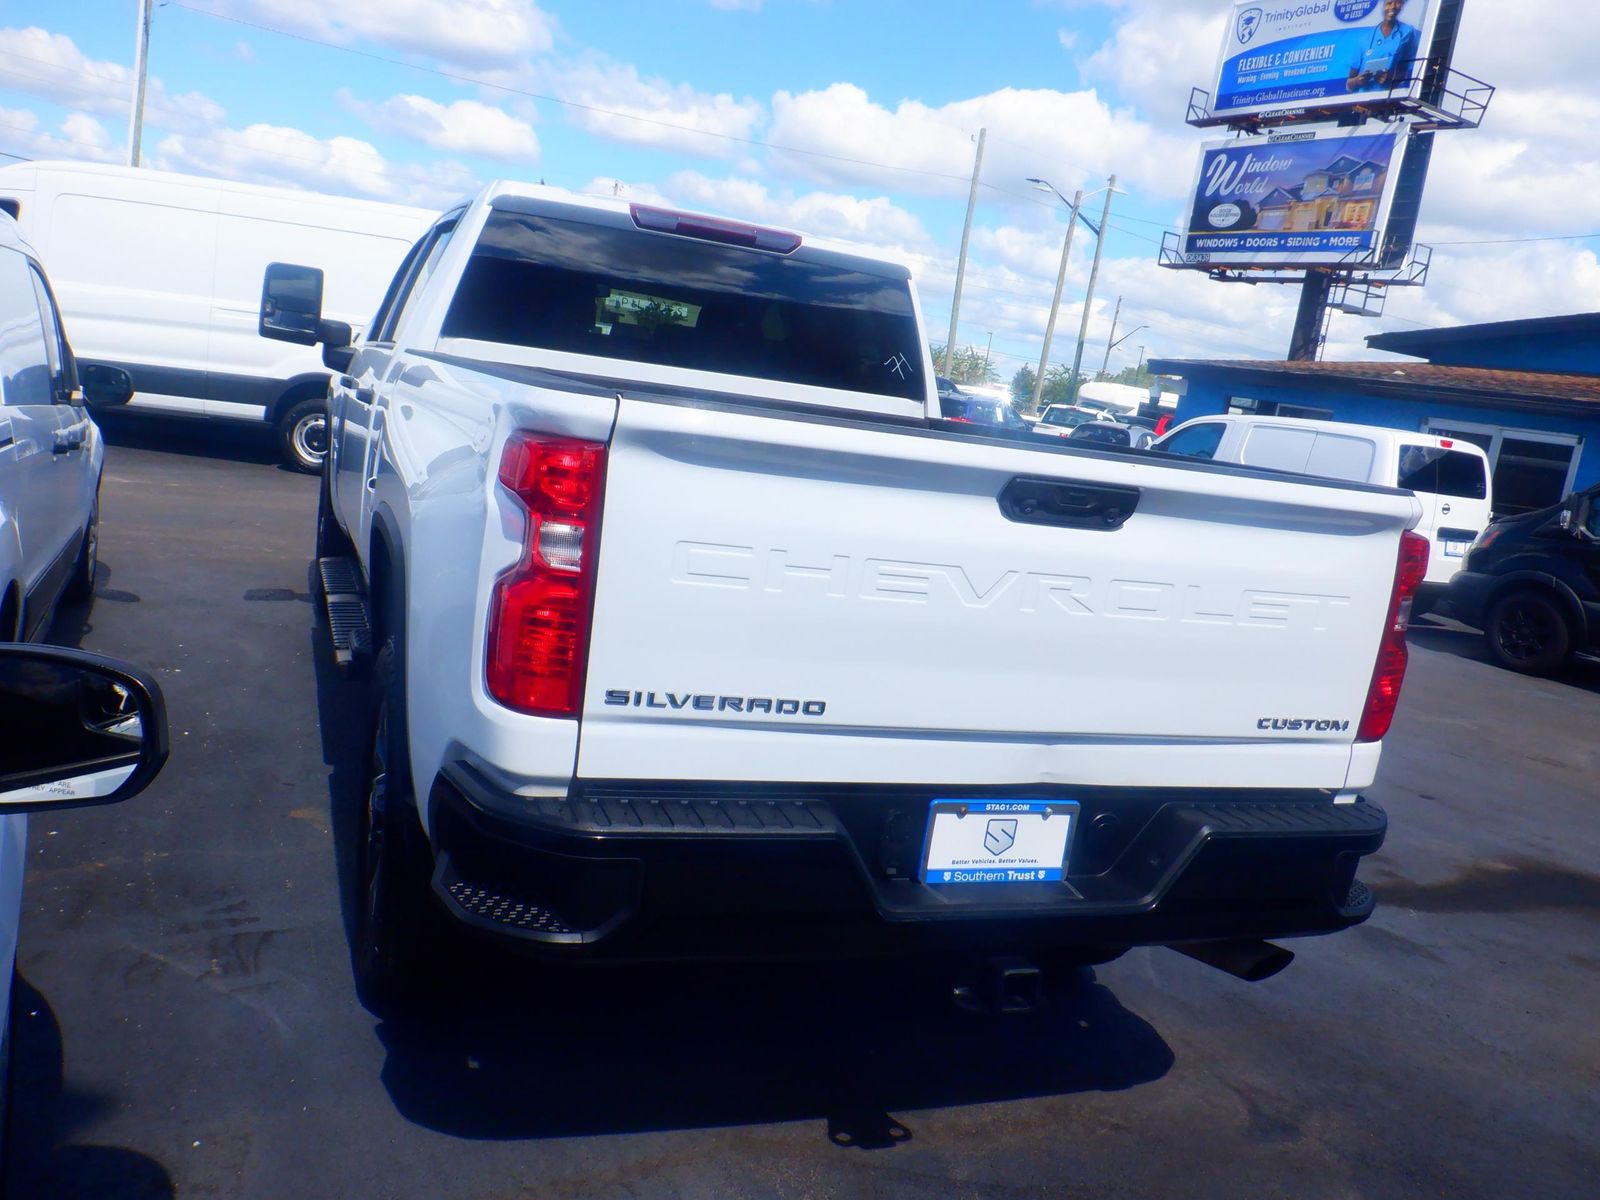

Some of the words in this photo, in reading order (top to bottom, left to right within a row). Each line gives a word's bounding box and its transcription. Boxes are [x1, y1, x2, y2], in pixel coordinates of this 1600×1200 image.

[1265, 0, 1330, 23] TrinityGlobal
[1238, 54, 1273, 71] FLEXIBLE
[1274, 53, 1281, 65] &
[1282, 44, 1336, 64] CONVENIENT
[1283, 67, 1307, 77] Weekend
[1307, 65, 1328, 74] Classes
[1196, 238, 1238, 248] WINDOWS
[1245, 238, 1278, 247] DOORS
[1286, 237, 1320, 247] SIDING
[1328, 236, 1360, 246] MORE
[672, 540, 1351, 631] CHEVROLET
[604, 690, 826, 715] SILVERADO
[1256, 718, 1350, 731] CUSTOM
[48, 787, 75, 795] APPEAR
[954, 871, 1005, 881] Southern
[1007, 870, 1035, 880] Trust
